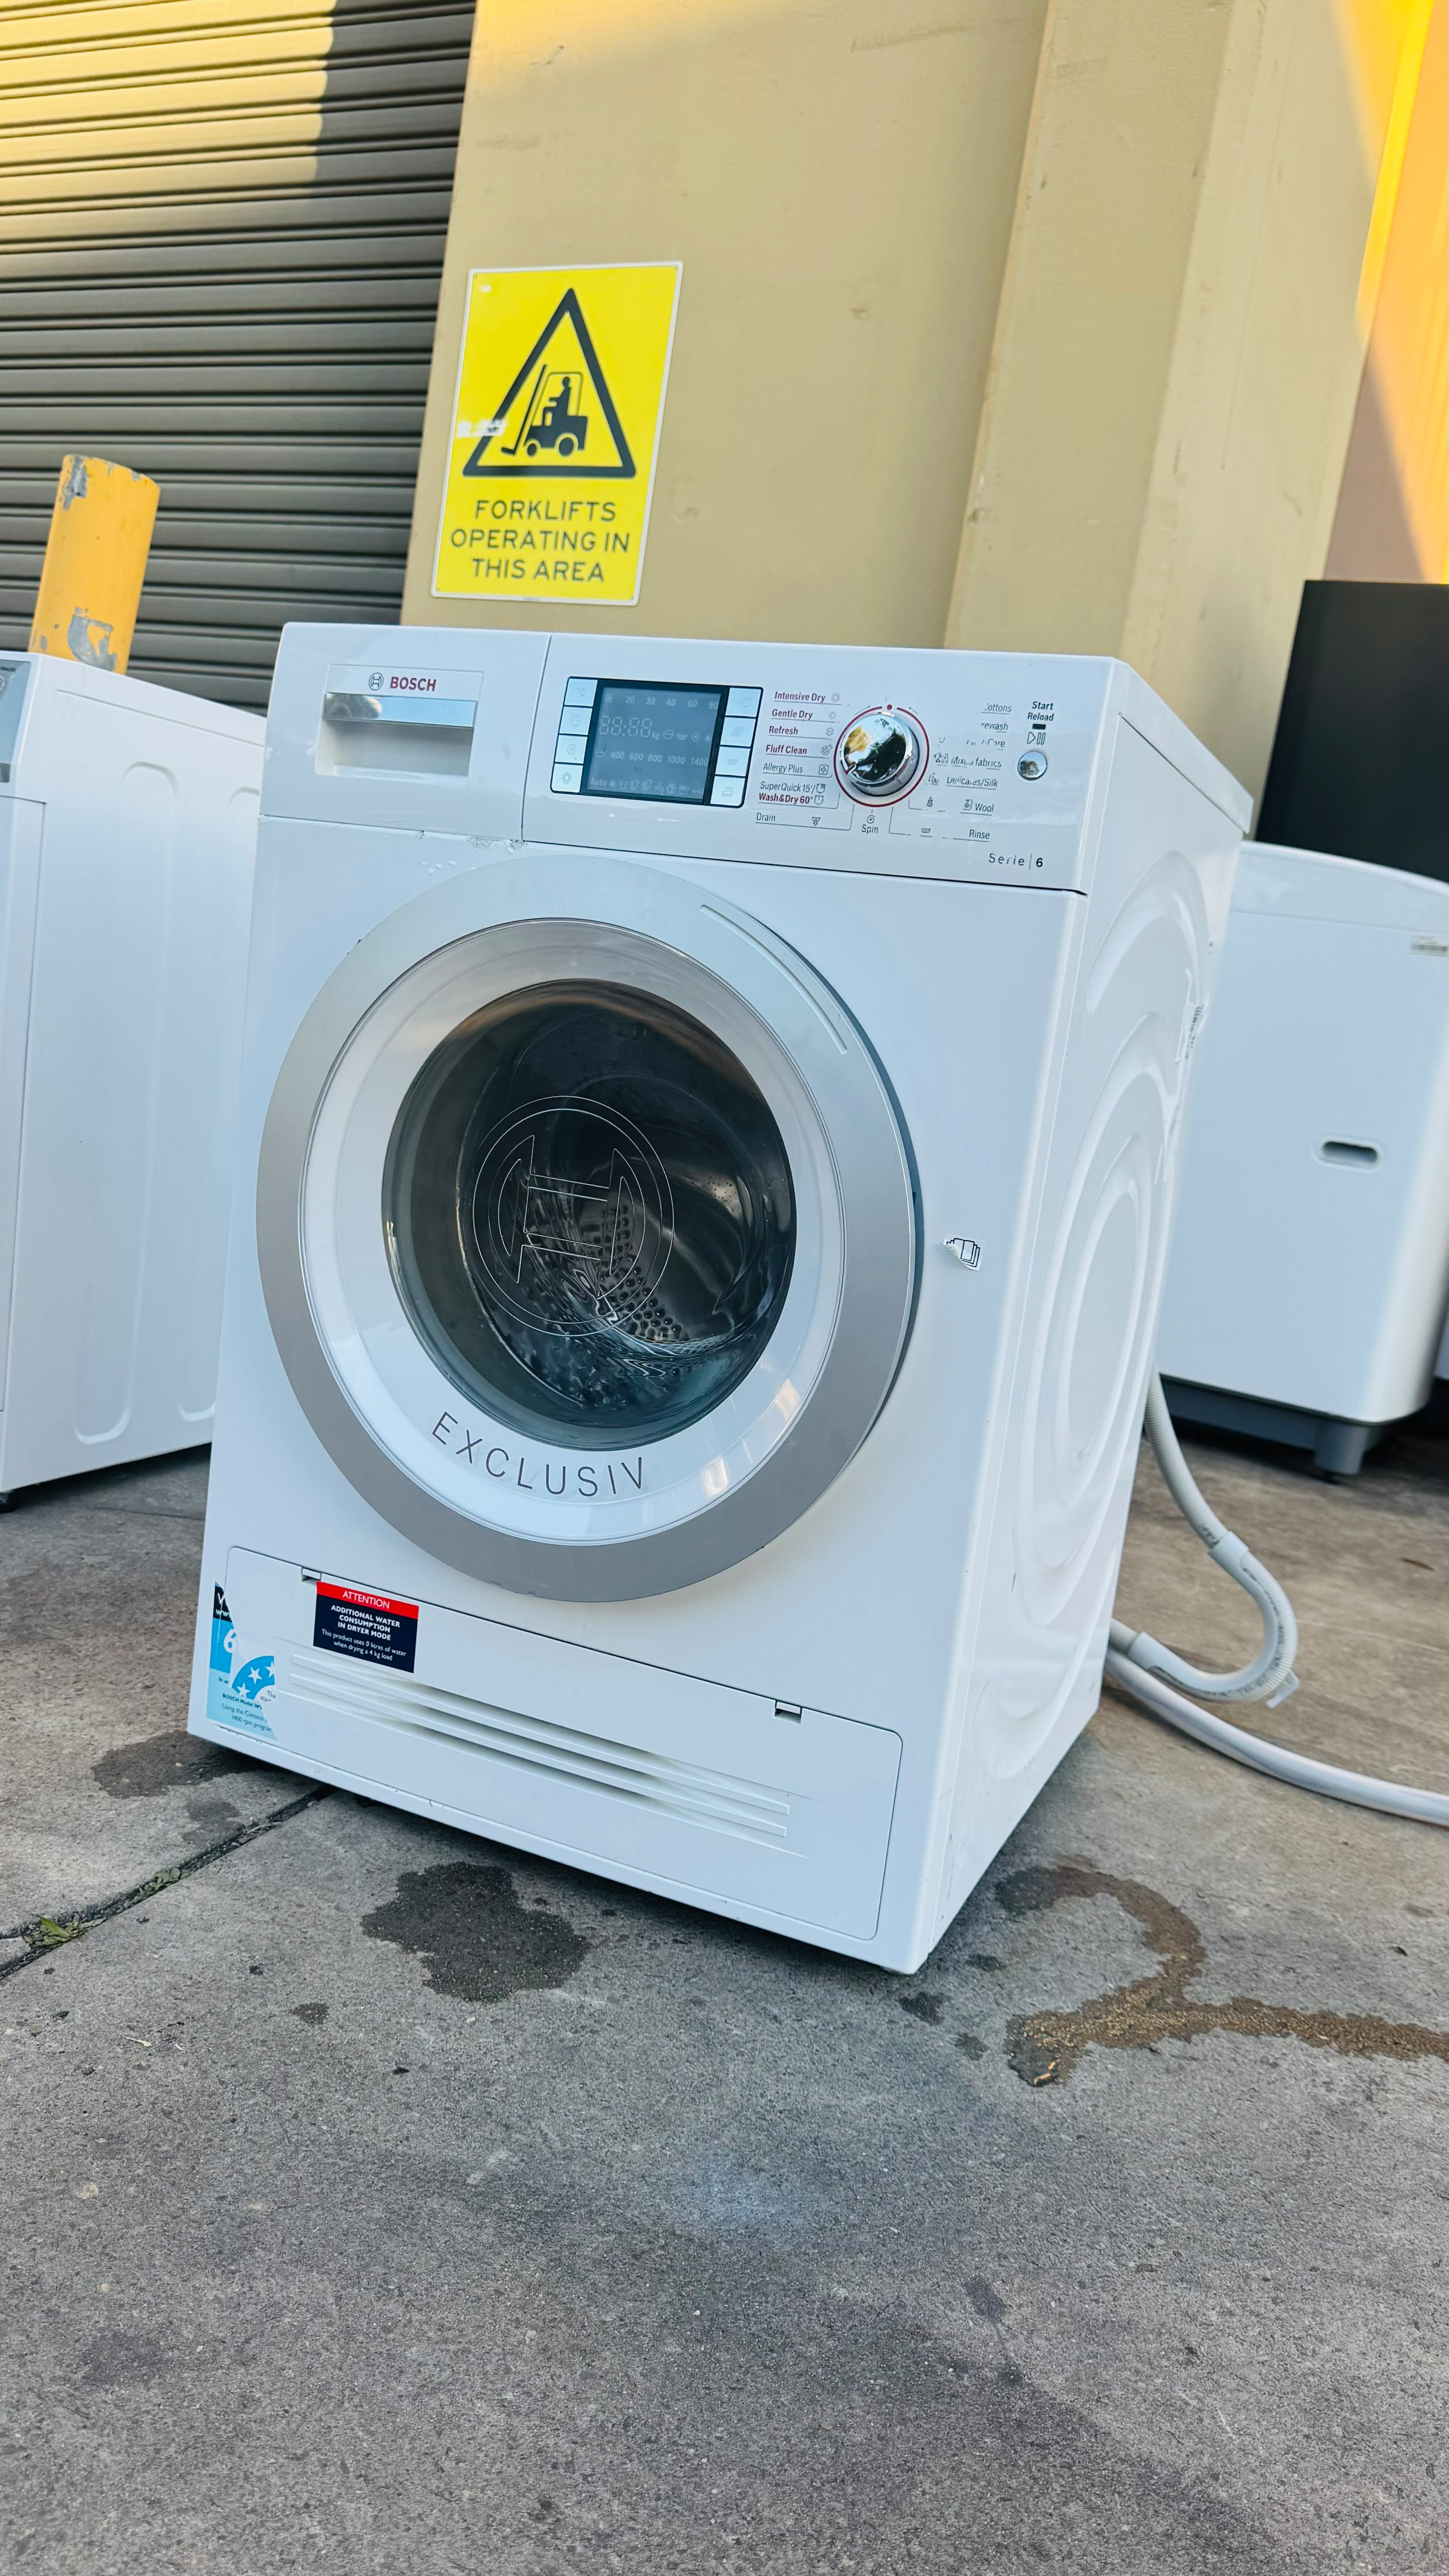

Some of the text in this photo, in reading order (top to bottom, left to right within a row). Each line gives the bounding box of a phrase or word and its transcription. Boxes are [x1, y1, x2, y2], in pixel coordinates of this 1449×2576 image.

[475, 500, 615, 522] FORKLIFTS
[452, 529, 630, 552] OPERATING IN
[472, 558, 604, 583] THIS AREA
[390, 676, 437, 692] BOSCH
[625, 696, 719, 709] 20 30 40 60 90
[774, 691, 825, 703] Intensive Dry
[1031, 701, 1054, 710] Start
[772, 708, 813, 720] Gentle Dry
[1027, 712, 1055, 721] Reload
[769, 726, 798, 735] Refresh
[981, 722, 1008, 731] rewash
[766, 745, 807, 754] Fluff Clean
[610, 751, 709, 767] 400 600 800 1000 1400
[975, 758, 1002, 768] fabrics
[763, 763, 803, 774] Allergy Plus
[591, 778, 607, 786] Auto
[759, 792, 798, 805] Wash&Dry
[975, 803, 994, 813] Wool
[757, 813, 775, 822] Drain
[861, 824, 878, 834] Spin
[969, 829, 990, 839] Rinse
[989, 853, 1043, 867] Serie 6
[432, 1411, 642, 1497] EXCLUSIV
[342, 1590, 390, 1609] ATTENTION
[331, 1604, 400, 1628] ADDITIONAL WATER
[339, 1615, 390, 1633] CONSUMPTION
[347, 1624, 369, 1635] DRYER
[371, 1630, 391, 1641] MODE
[321, 1629, 332, 1637] This
[333, 1633, 353, 1642] product
[370, 1642, 383, 1651] litres
[348, 1644, 363, 1654] drying
[222, 1694, 239, 1702] BOSCH
[267, 1691, 276, 1699] The
[222, 1703, 235, 1713] Using
[232, 1715, 243, 1723] 1400
